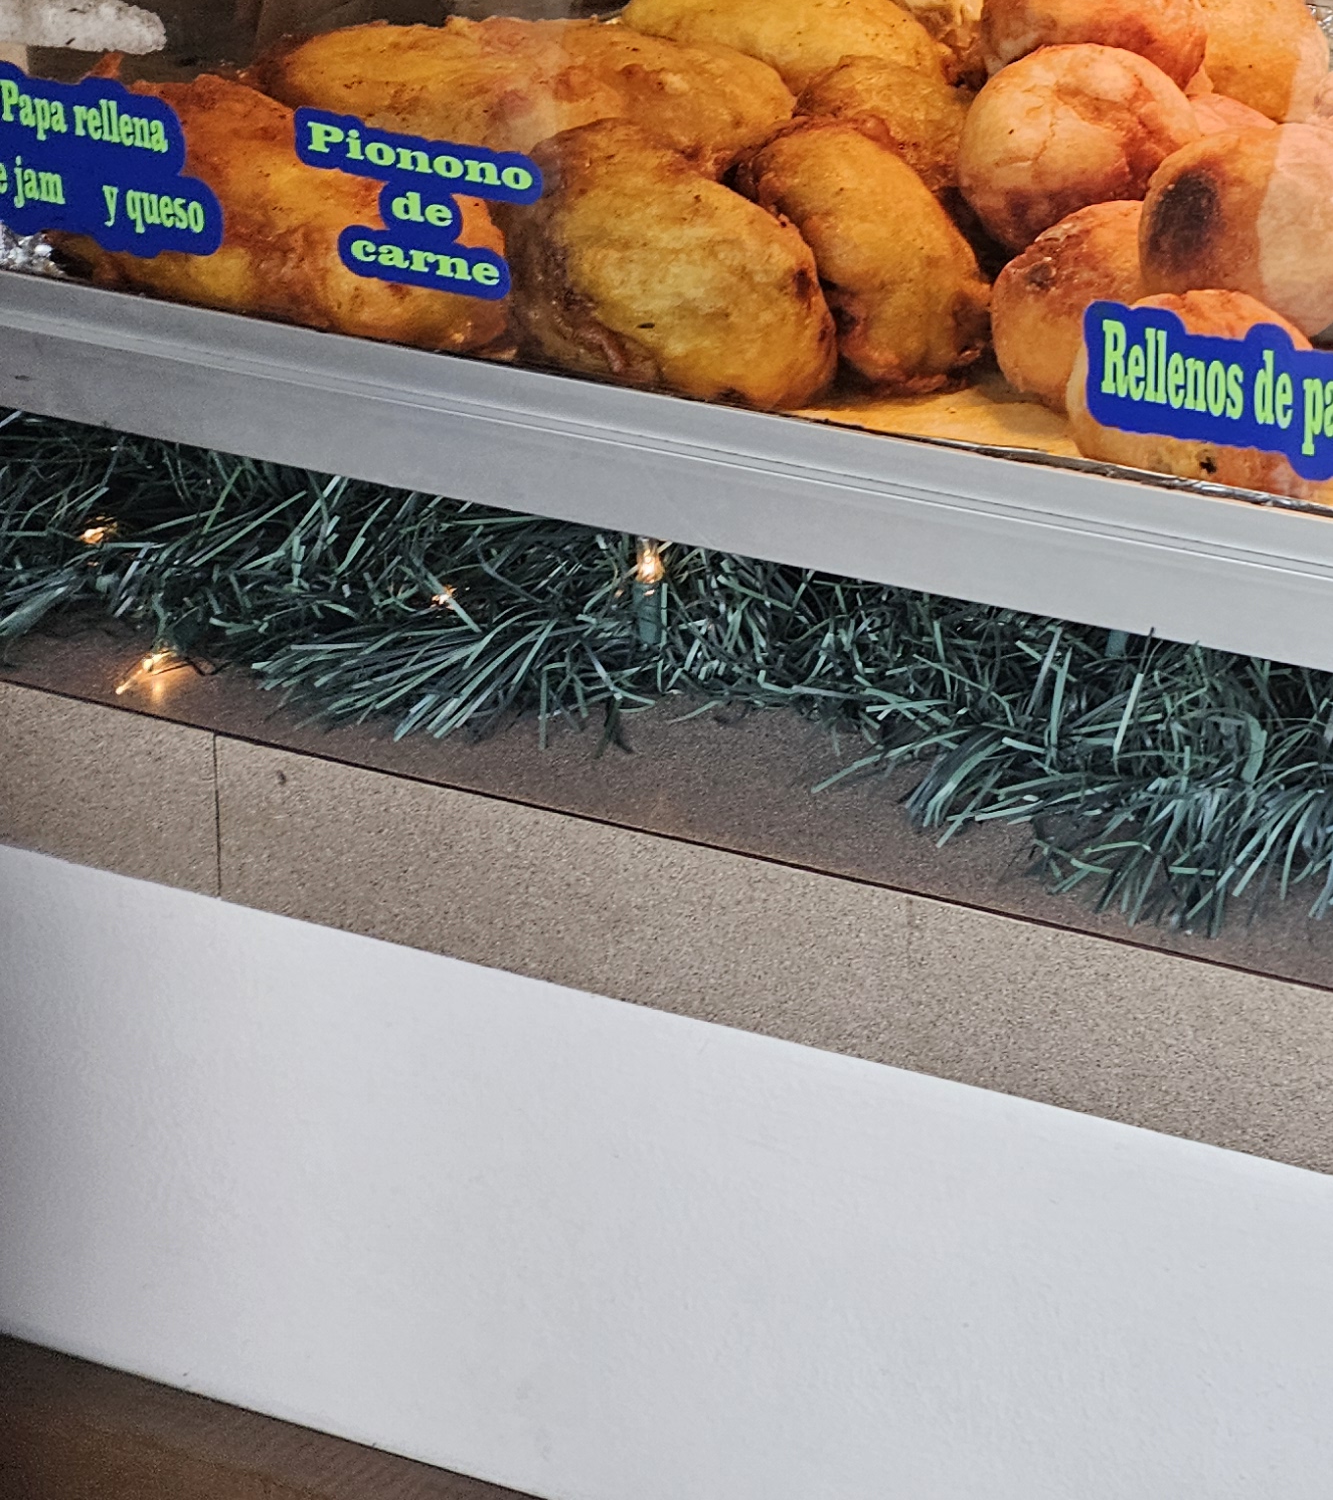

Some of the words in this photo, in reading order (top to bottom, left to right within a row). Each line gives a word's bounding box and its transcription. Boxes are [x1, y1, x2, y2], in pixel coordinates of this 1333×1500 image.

[0, 79, 68, 141] Papa
[73, 99, 168, 153] rellena
[307, 121, 534, 191] Pionono
[14, 155, 66, 208] jam
[102, 185, 119, 227] y
[126, 189, 204, 233] queso
[391, 192, 453, 228] de
[350, 238, 501, 286] carne
[1101, 319, 1244, 419] Rellenos
[1254, 350, 1294, 430] de
